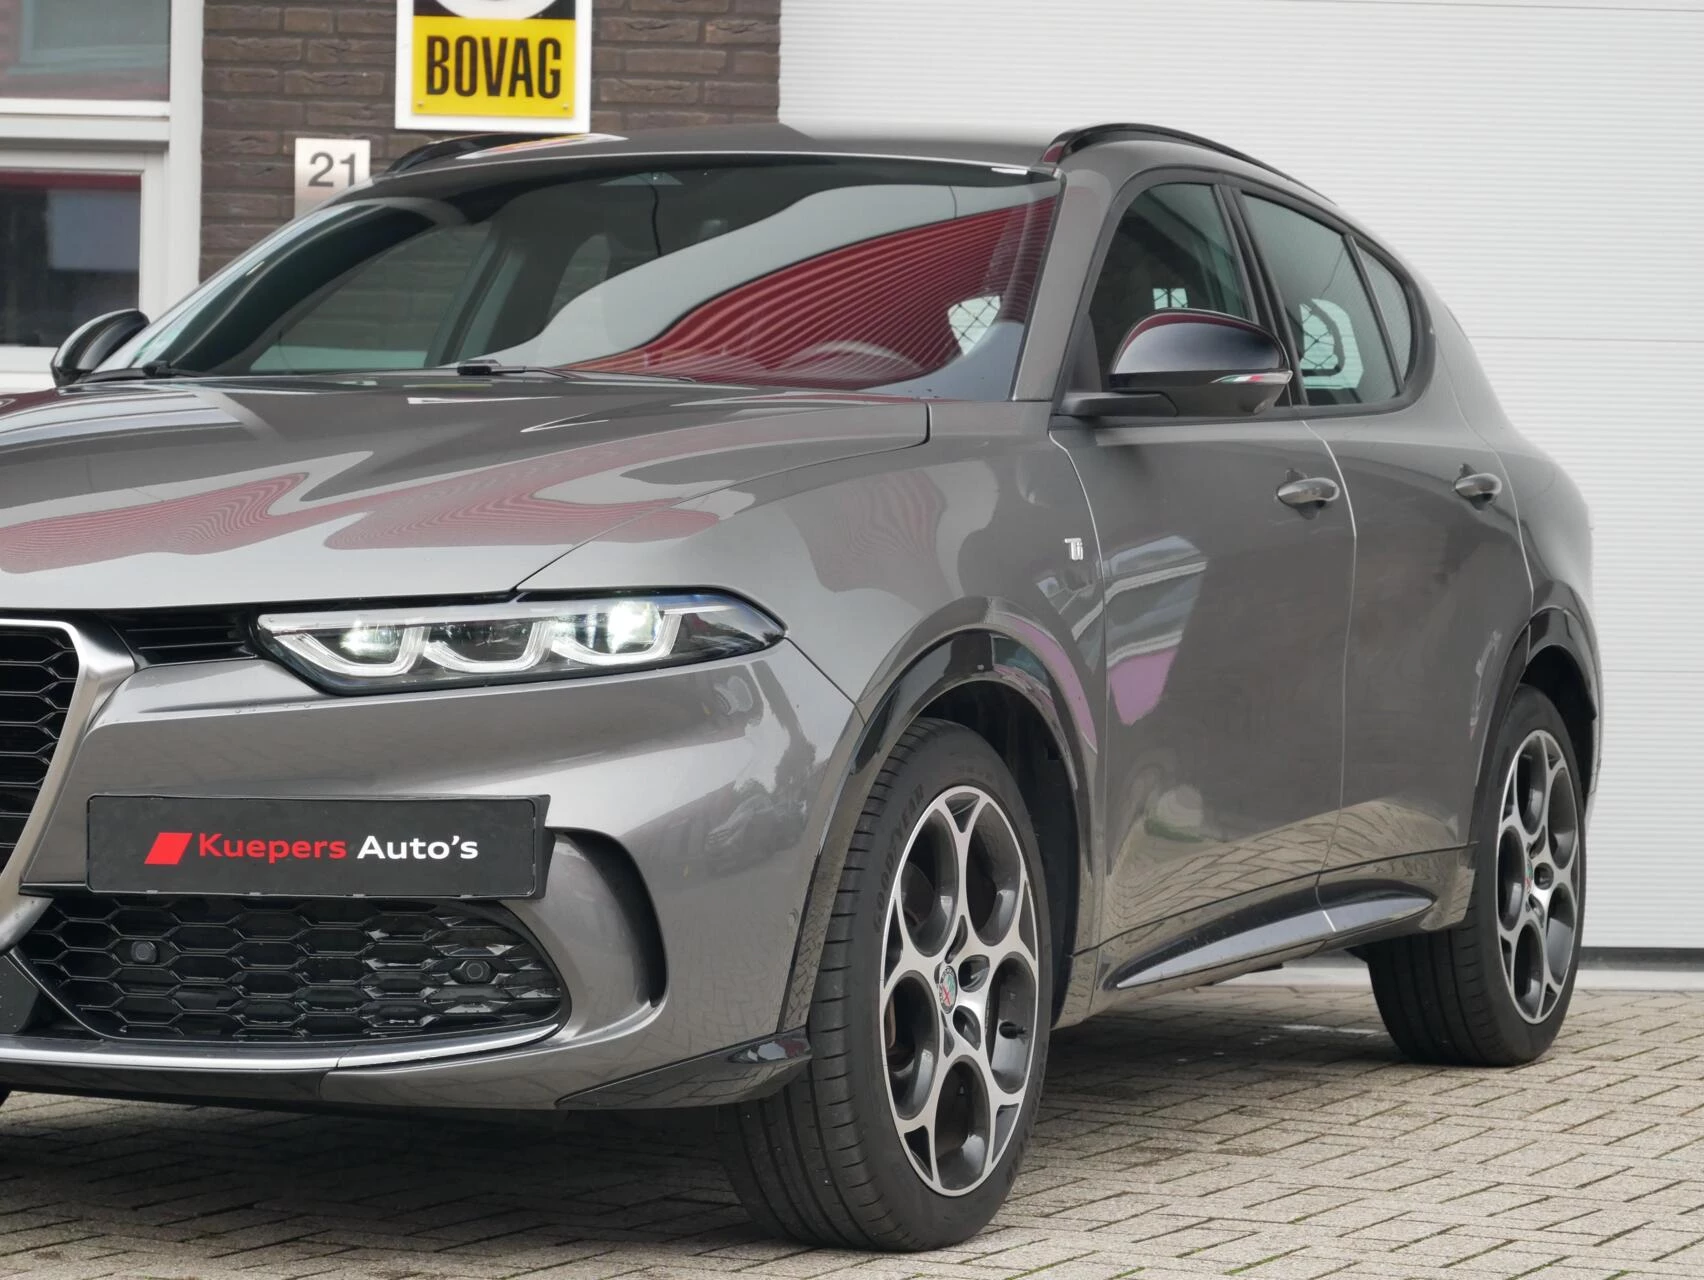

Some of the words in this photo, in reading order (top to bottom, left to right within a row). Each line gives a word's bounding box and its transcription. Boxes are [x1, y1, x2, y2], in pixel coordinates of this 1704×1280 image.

[426, 35, 562, 99] BOVAG
[308, 152, 357, 187] 21
[198, 833, 347, 864] Kuepers
